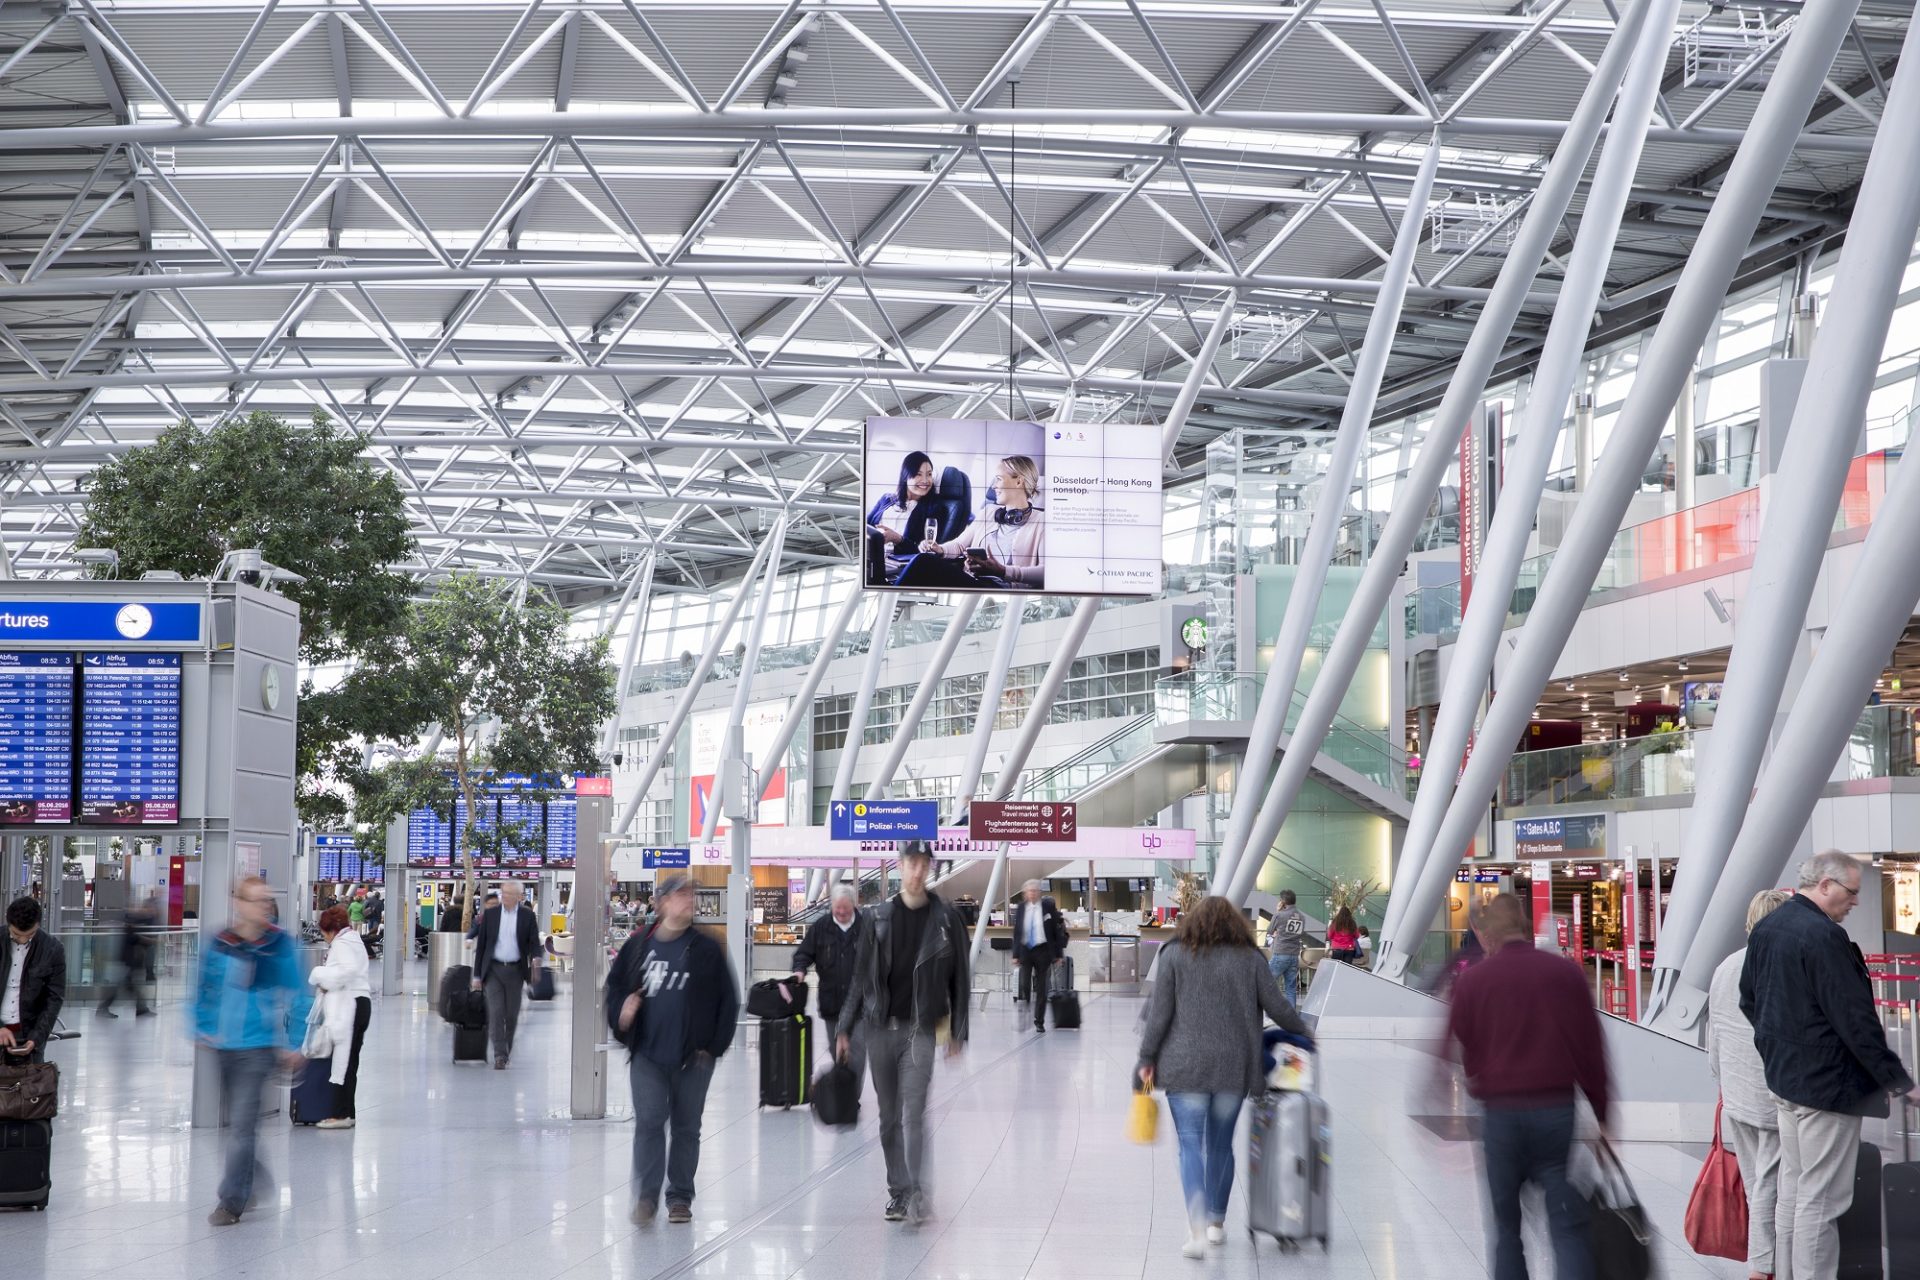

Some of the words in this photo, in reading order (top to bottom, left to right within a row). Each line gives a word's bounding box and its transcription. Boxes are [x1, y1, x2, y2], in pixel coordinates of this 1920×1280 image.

[1053, 476, 1098, 484] Düsseldorf
[1107, 478, 1128, 487] Hong
[1131, 478, 1152, 488] Kong
[1053, 486, 1090, 494] nonstop.
[1527, 823, 1543, 835] Gates
[1544, 821, 1560, 836] A,B,C
[1142, 833, 1161, 848] bb
[704, 847, 719, 858] bb
[1287, 920, 1302, 934] 67
